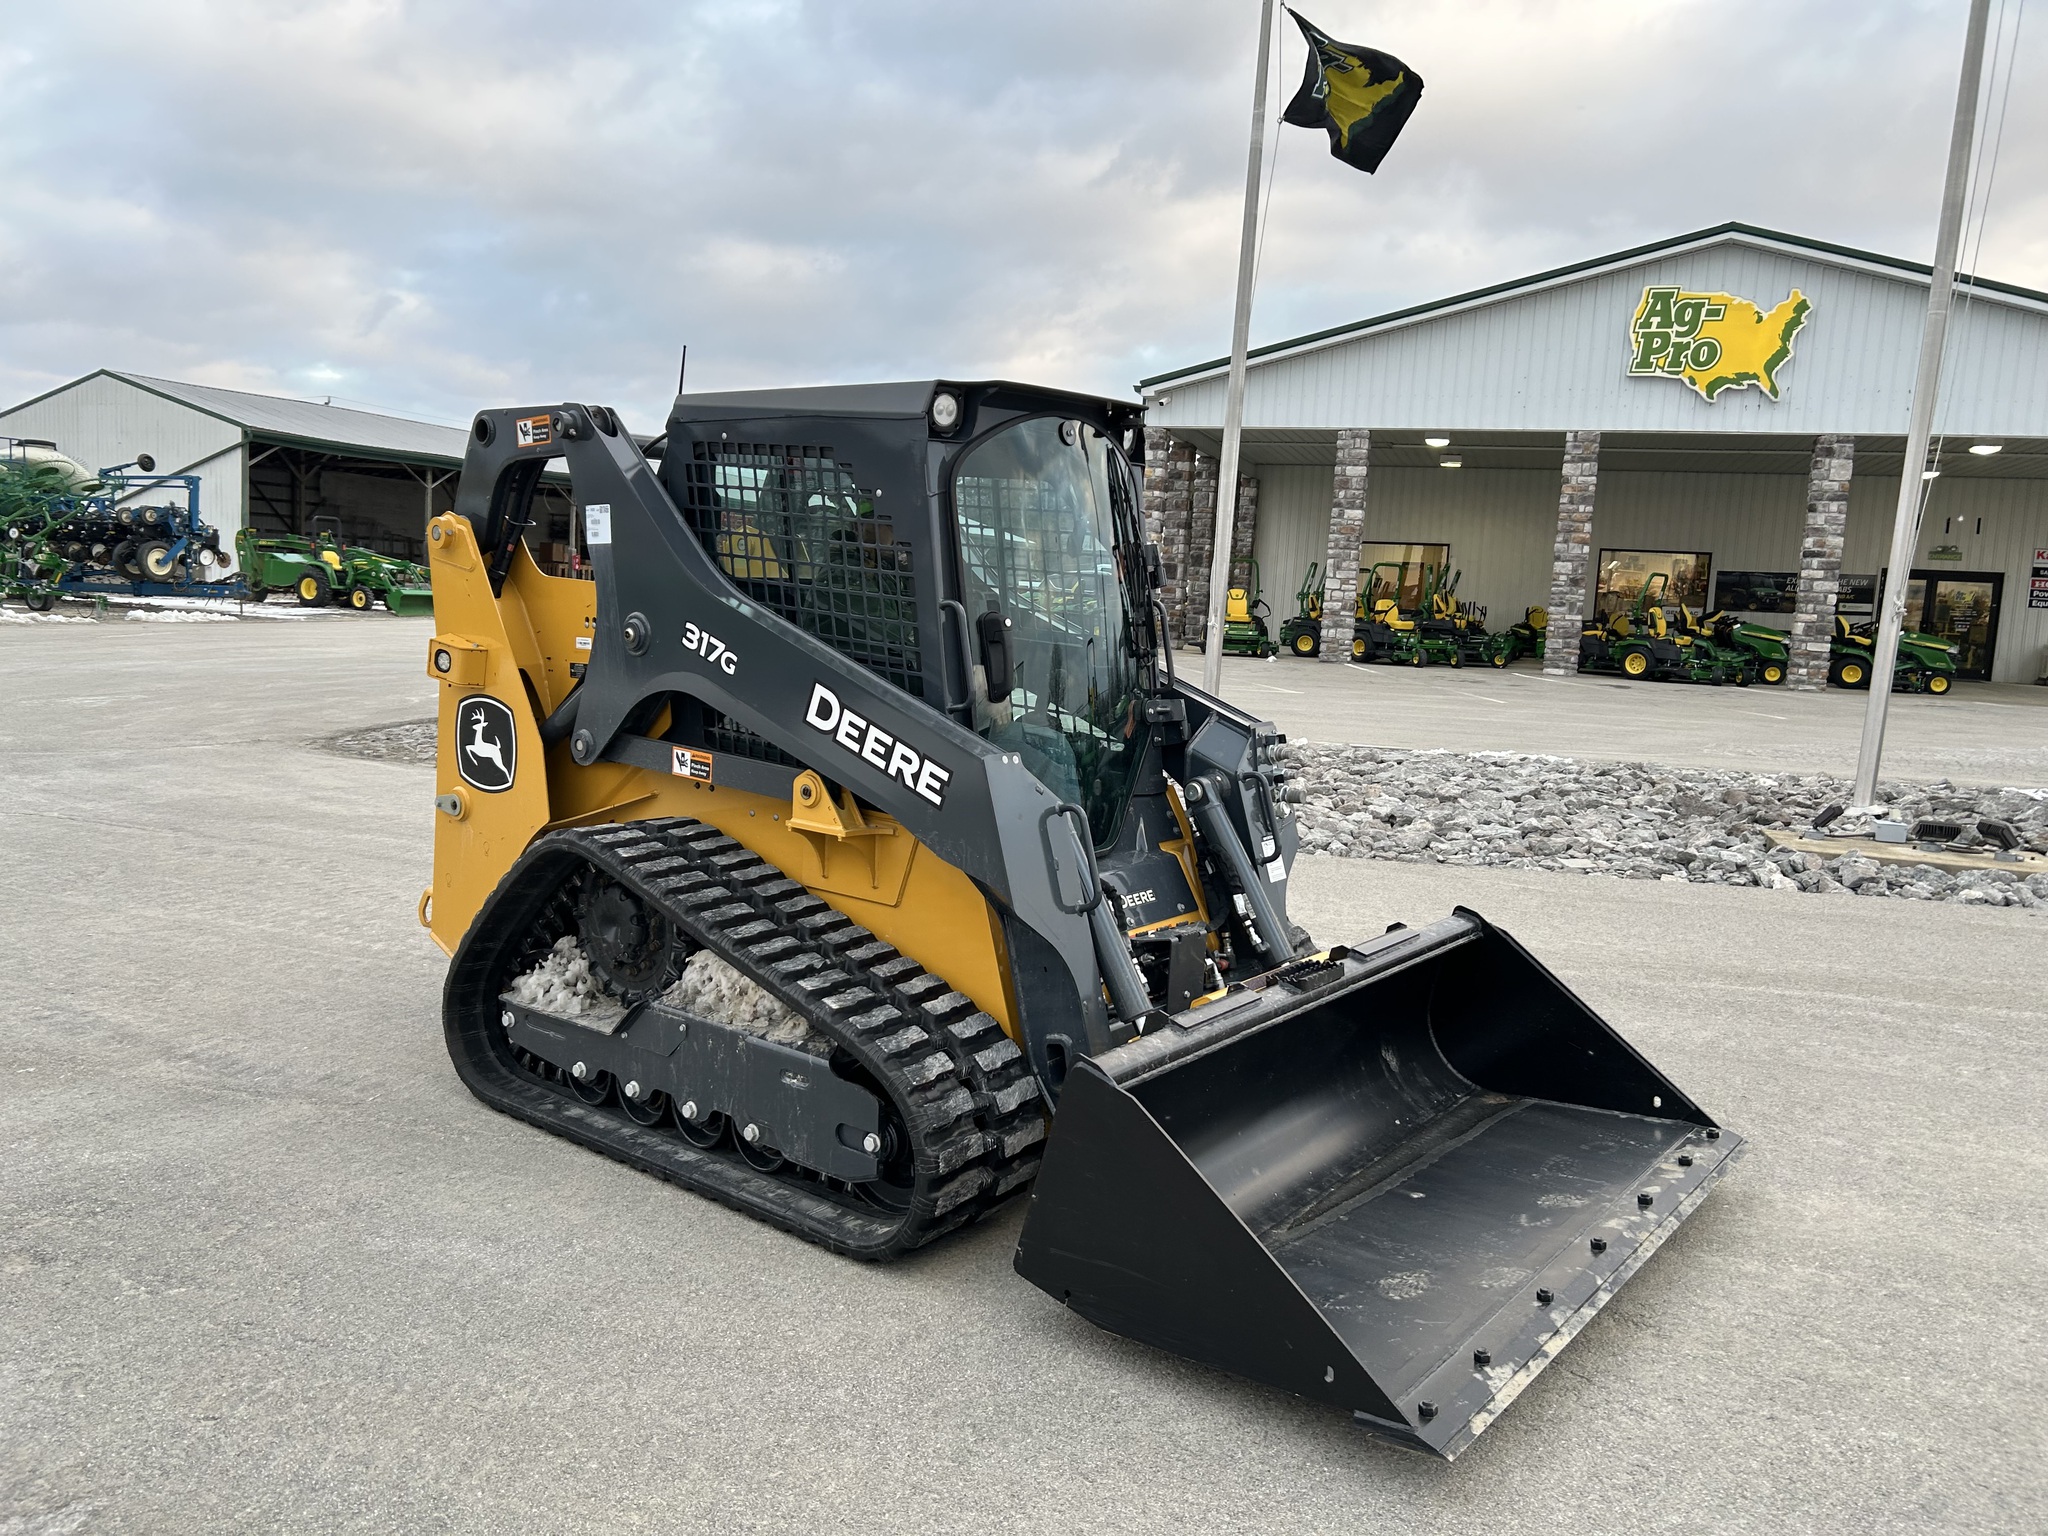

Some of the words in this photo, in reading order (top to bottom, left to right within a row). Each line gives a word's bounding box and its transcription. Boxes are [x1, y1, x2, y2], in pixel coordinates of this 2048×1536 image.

[1634, 287, 1726, 339] Ag-
[1630, 331, 1722, 373] Pro
[2036, 550, 2048, 560] K
[1838, 586, 1852, 594] ABS
[681, 621, 738, 675] 317G
[805, 682, 950, 806] DEERE
